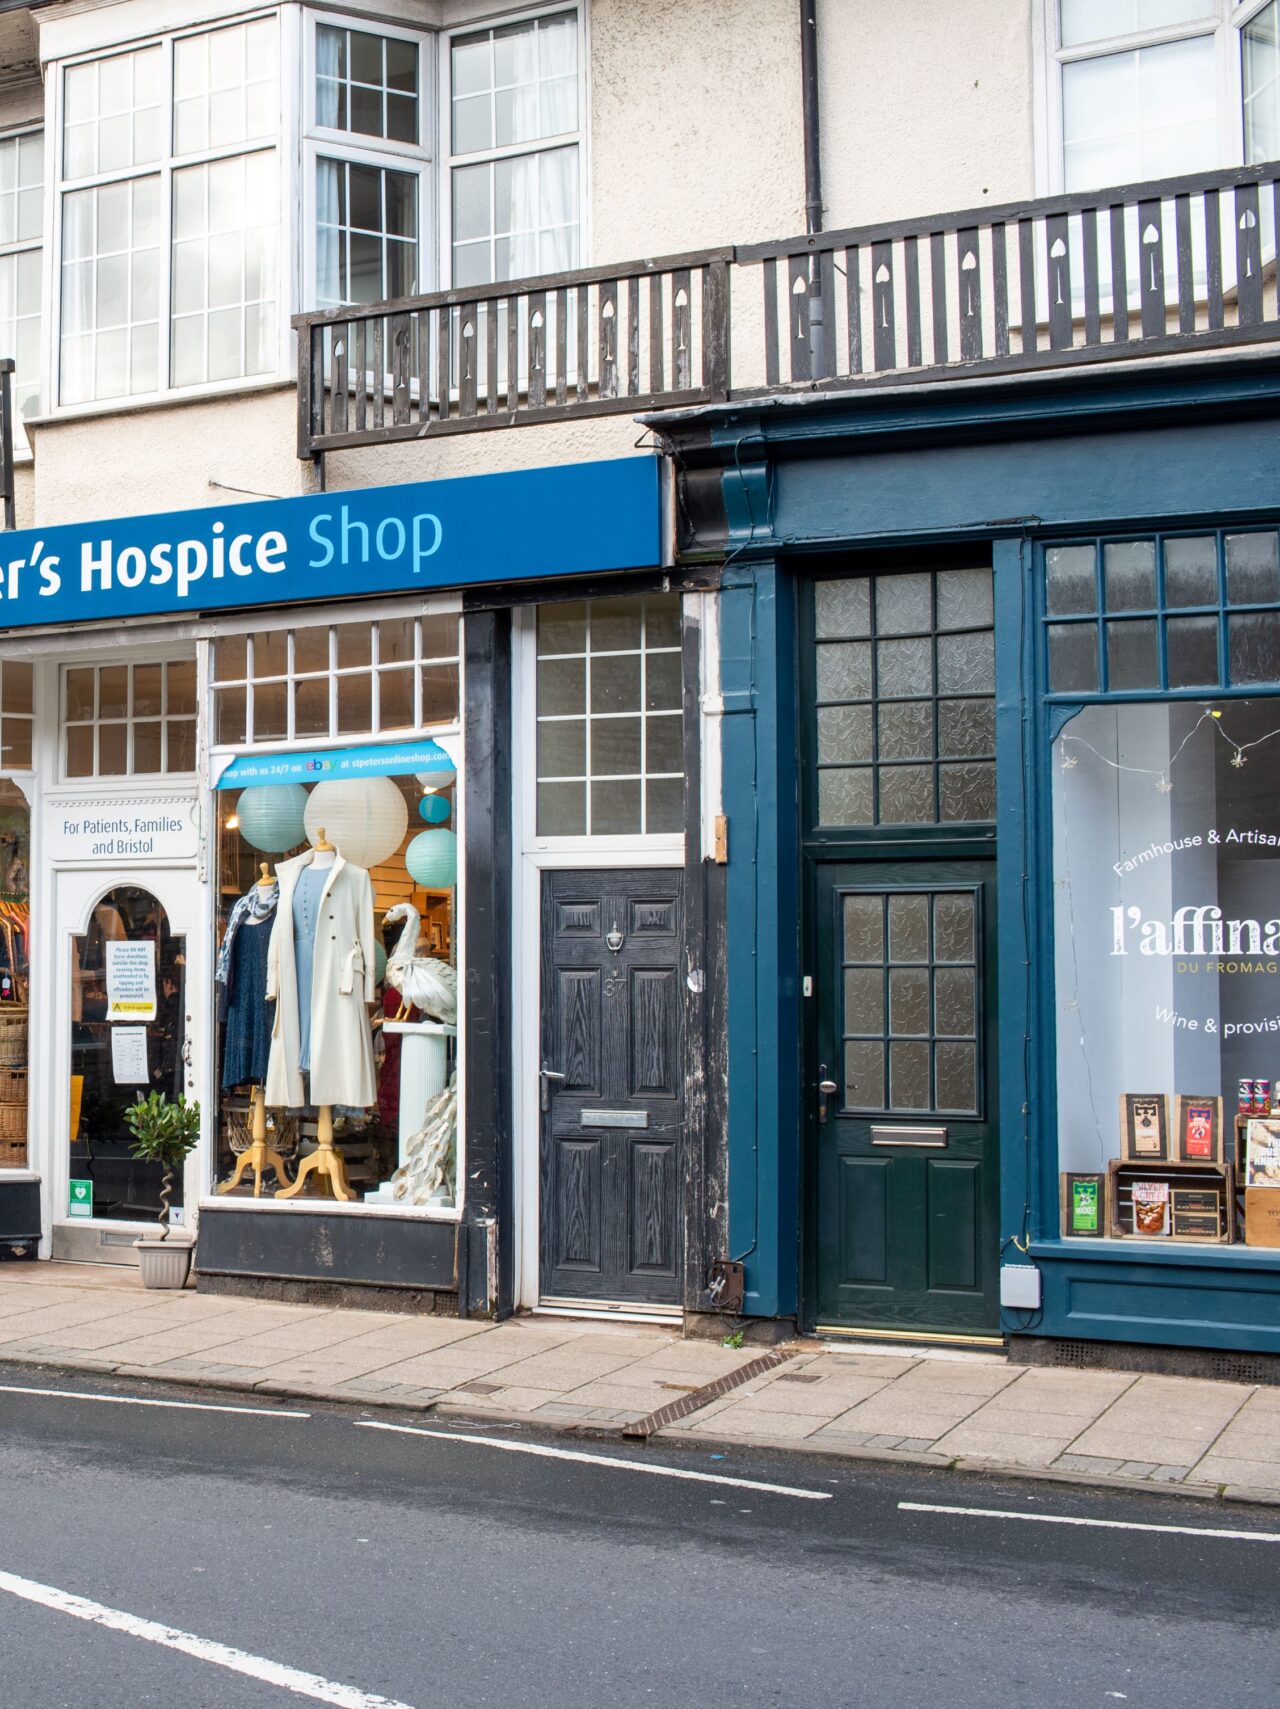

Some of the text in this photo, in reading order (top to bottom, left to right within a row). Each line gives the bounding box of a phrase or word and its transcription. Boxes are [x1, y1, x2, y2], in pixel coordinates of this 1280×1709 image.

[80, 522, 288, 598] Hospice
[308, 505, 444, 573] Shop
[239, 766, 258, 777] with
[259, 767, 269, 776] us
[270, 763, 289, 775] 24/7
[291, 764, 302, 773] on
[305, 758, 337, 773] ebay
[340, 761, 350, 770] at
[63, 816, 183, 835] For Patients, Families
[92, 837, 153, 855] and Bristol
[1113, 834, 1202, 877] Farmhouse
[1207, 829, 1221, 845] &
[1177, 962, 1199, 973] DU
[604, 978, 628, 997] 37
[1154, 1005, 1199, 1031] Wine
[1204, 1018, 1218, 1033] &
